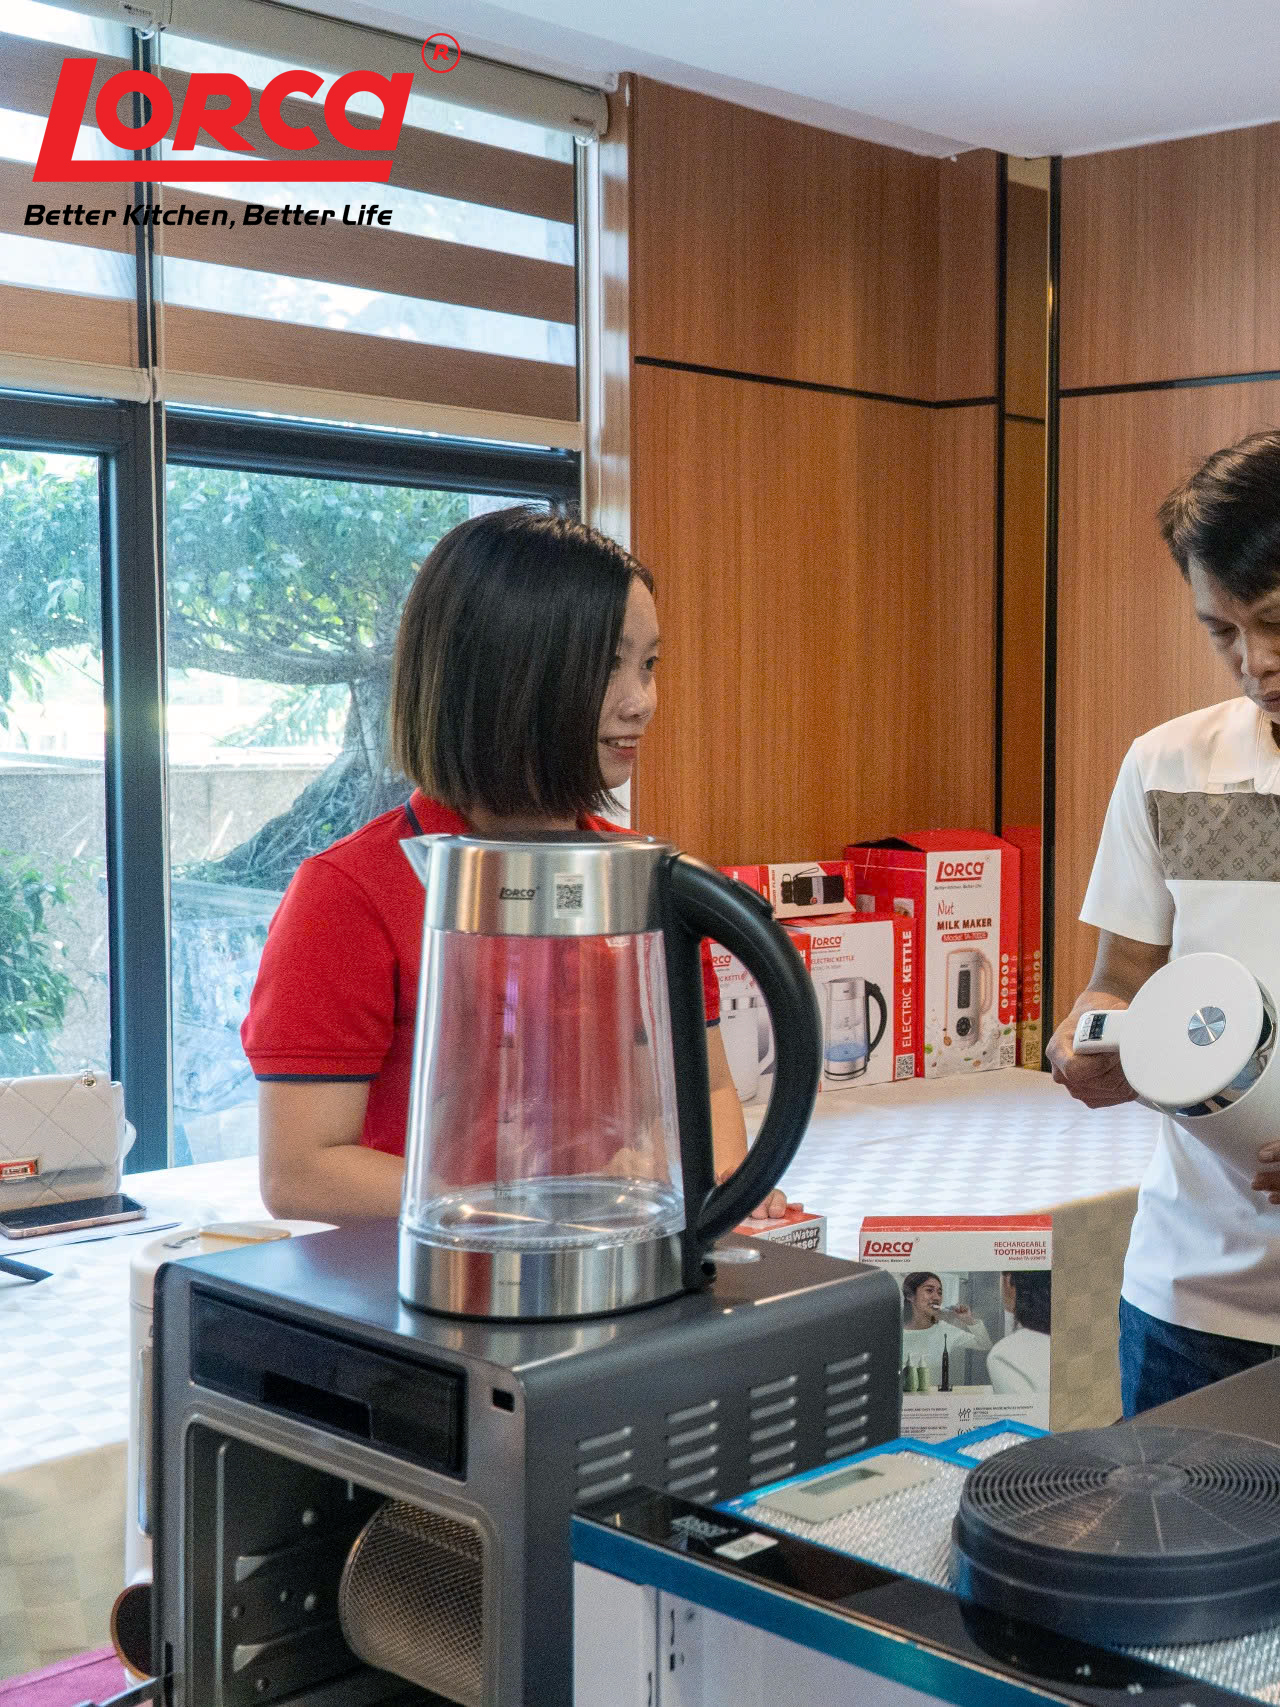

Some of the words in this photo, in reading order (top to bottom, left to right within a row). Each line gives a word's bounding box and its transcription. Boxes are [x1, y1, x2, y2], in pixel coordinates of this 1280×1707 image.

[937, 899, 954, 917] Nut
[937, 920, 960, 931] MILK
[962, 917, 992, 929] MAKER
[902, 930, 912, 983] KETTLE
[902, 988, 912, 1048] ELECTRIC
[792, 1228, 818, 1241] Water
[994, 1248, 1047, 1256] TOOTHBRUSH
